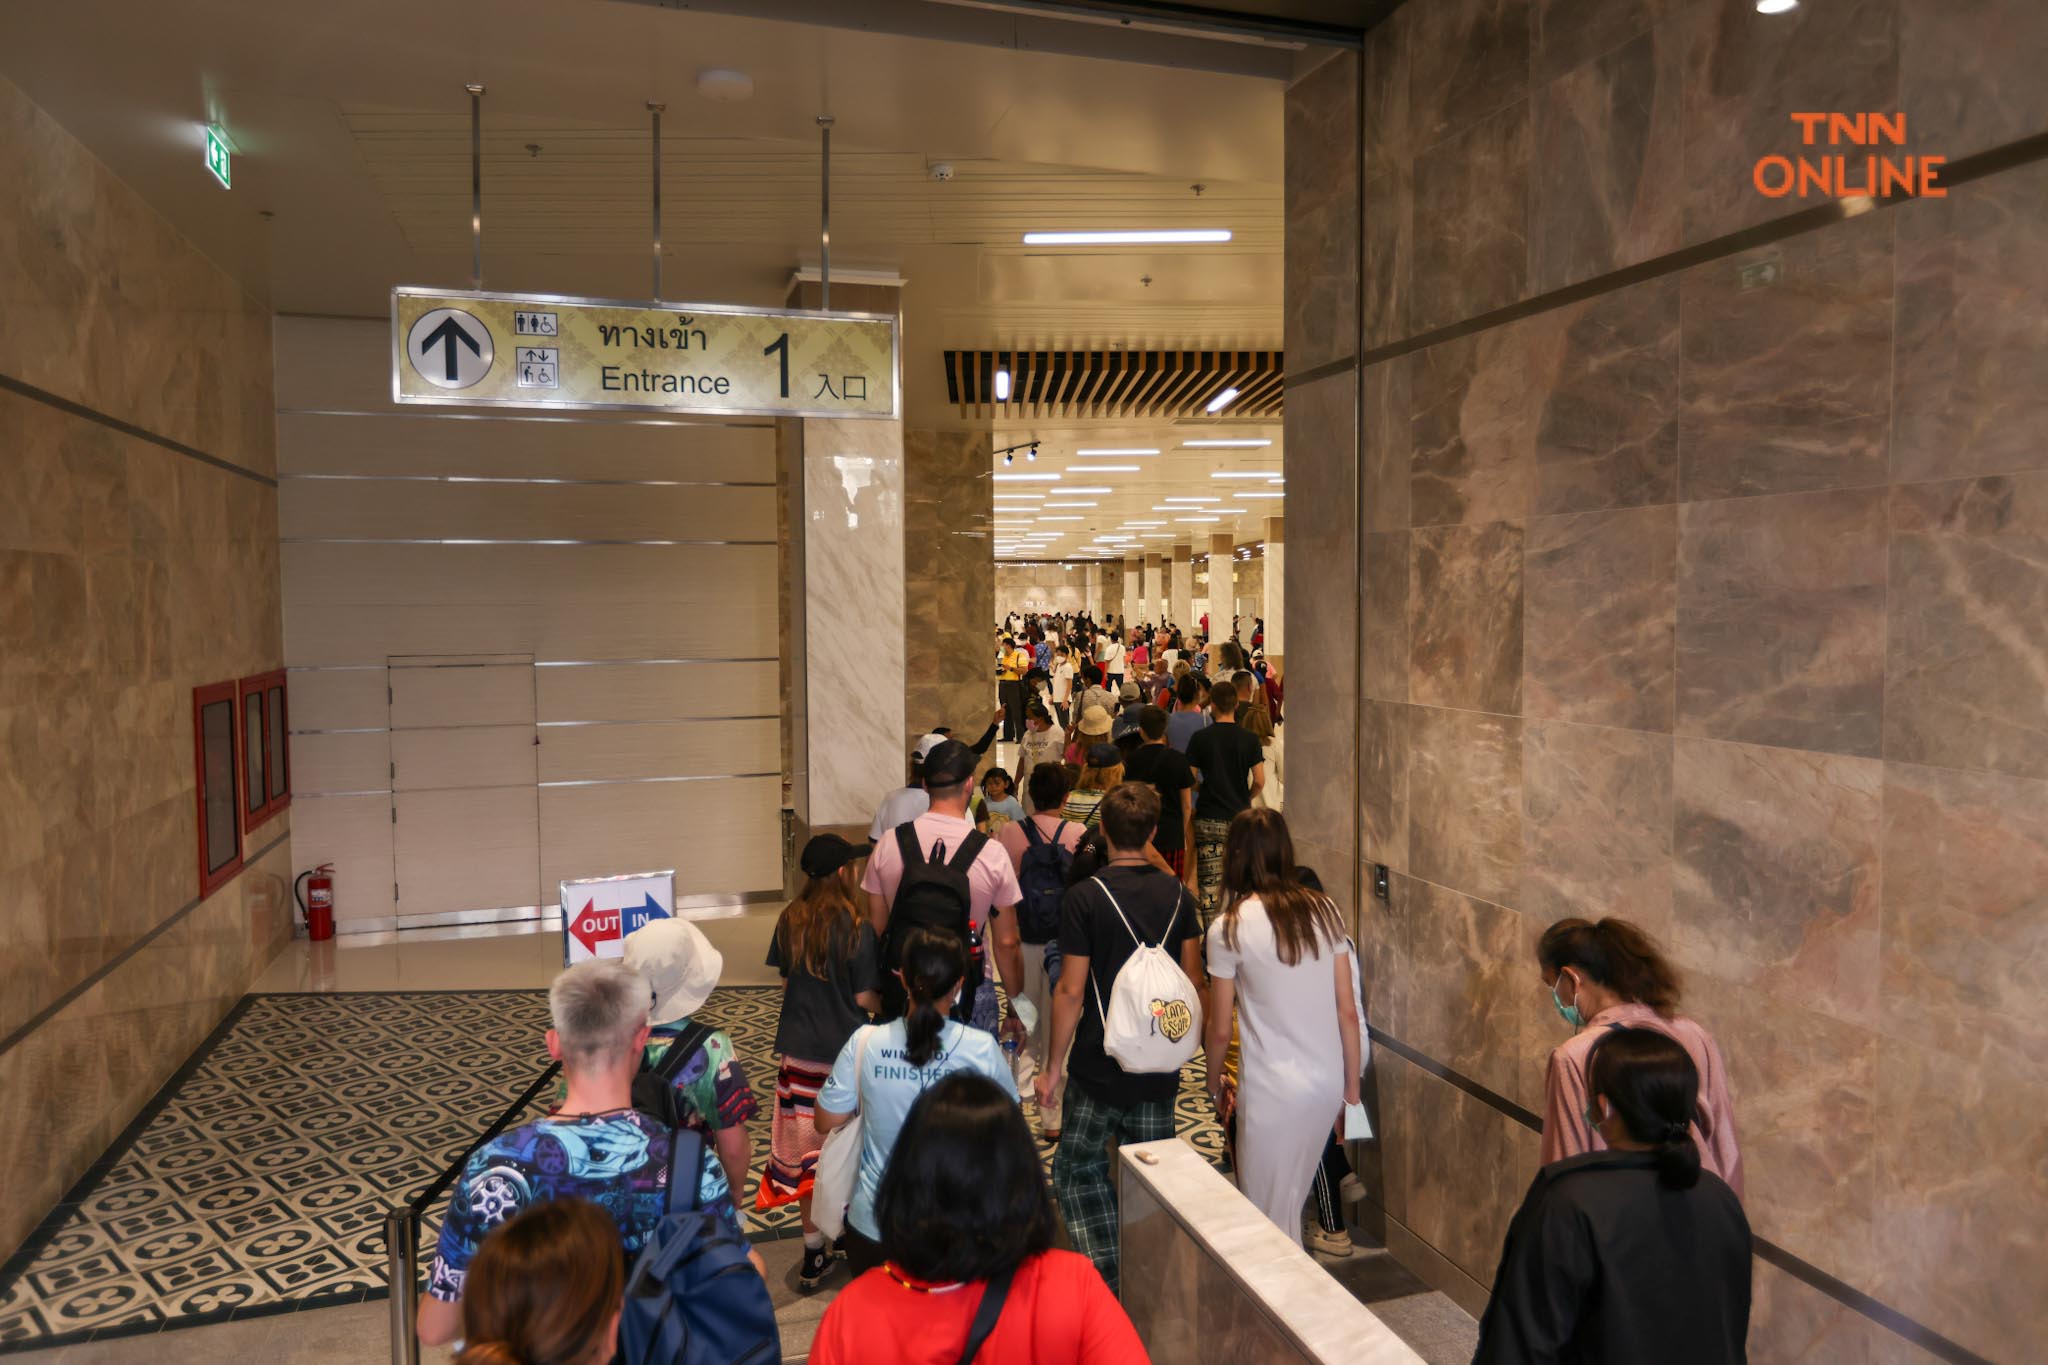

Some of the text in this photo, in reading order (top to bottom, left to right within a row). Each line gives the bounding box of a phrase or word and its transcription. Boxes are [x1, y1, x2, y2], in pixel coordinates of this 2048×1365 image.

[598, 315, 707, 351] ทางเข้า
[601, 365, 731, 395] Entrance
[763, 332, 790, 399] 1
[814, 373, 867, 401] 入口
[582, 916, 620, 934] OUT
[632, 912, 650, 928] IN
